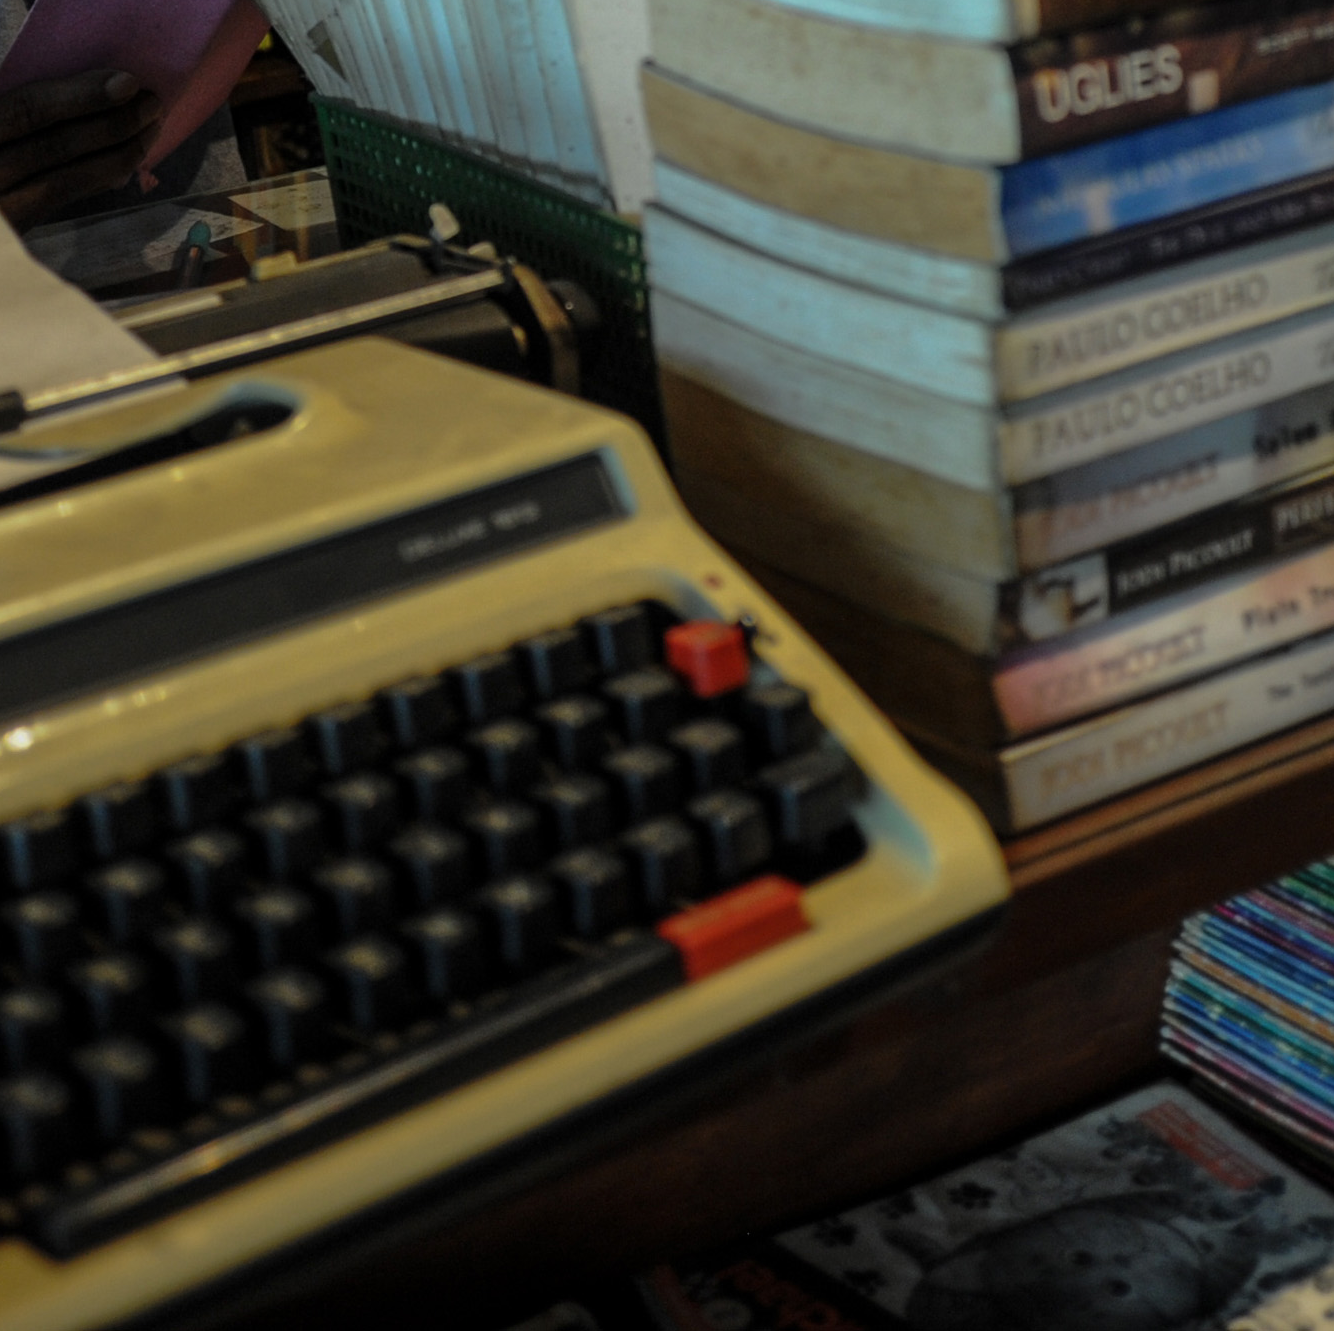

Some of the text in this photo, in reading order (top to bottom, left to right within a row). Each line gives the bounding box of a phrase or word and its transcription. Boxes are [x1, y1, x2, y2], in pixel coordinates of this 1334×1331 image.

[1030, 42, 1184, 125] UGLIES
[1026, 296, 1137, 373] PAULO
[1141, 271, 1267, 348] COELHO
[1029, 389, 1144, 457] PAULO
[1147, 347, 1273, 423] COELHO
